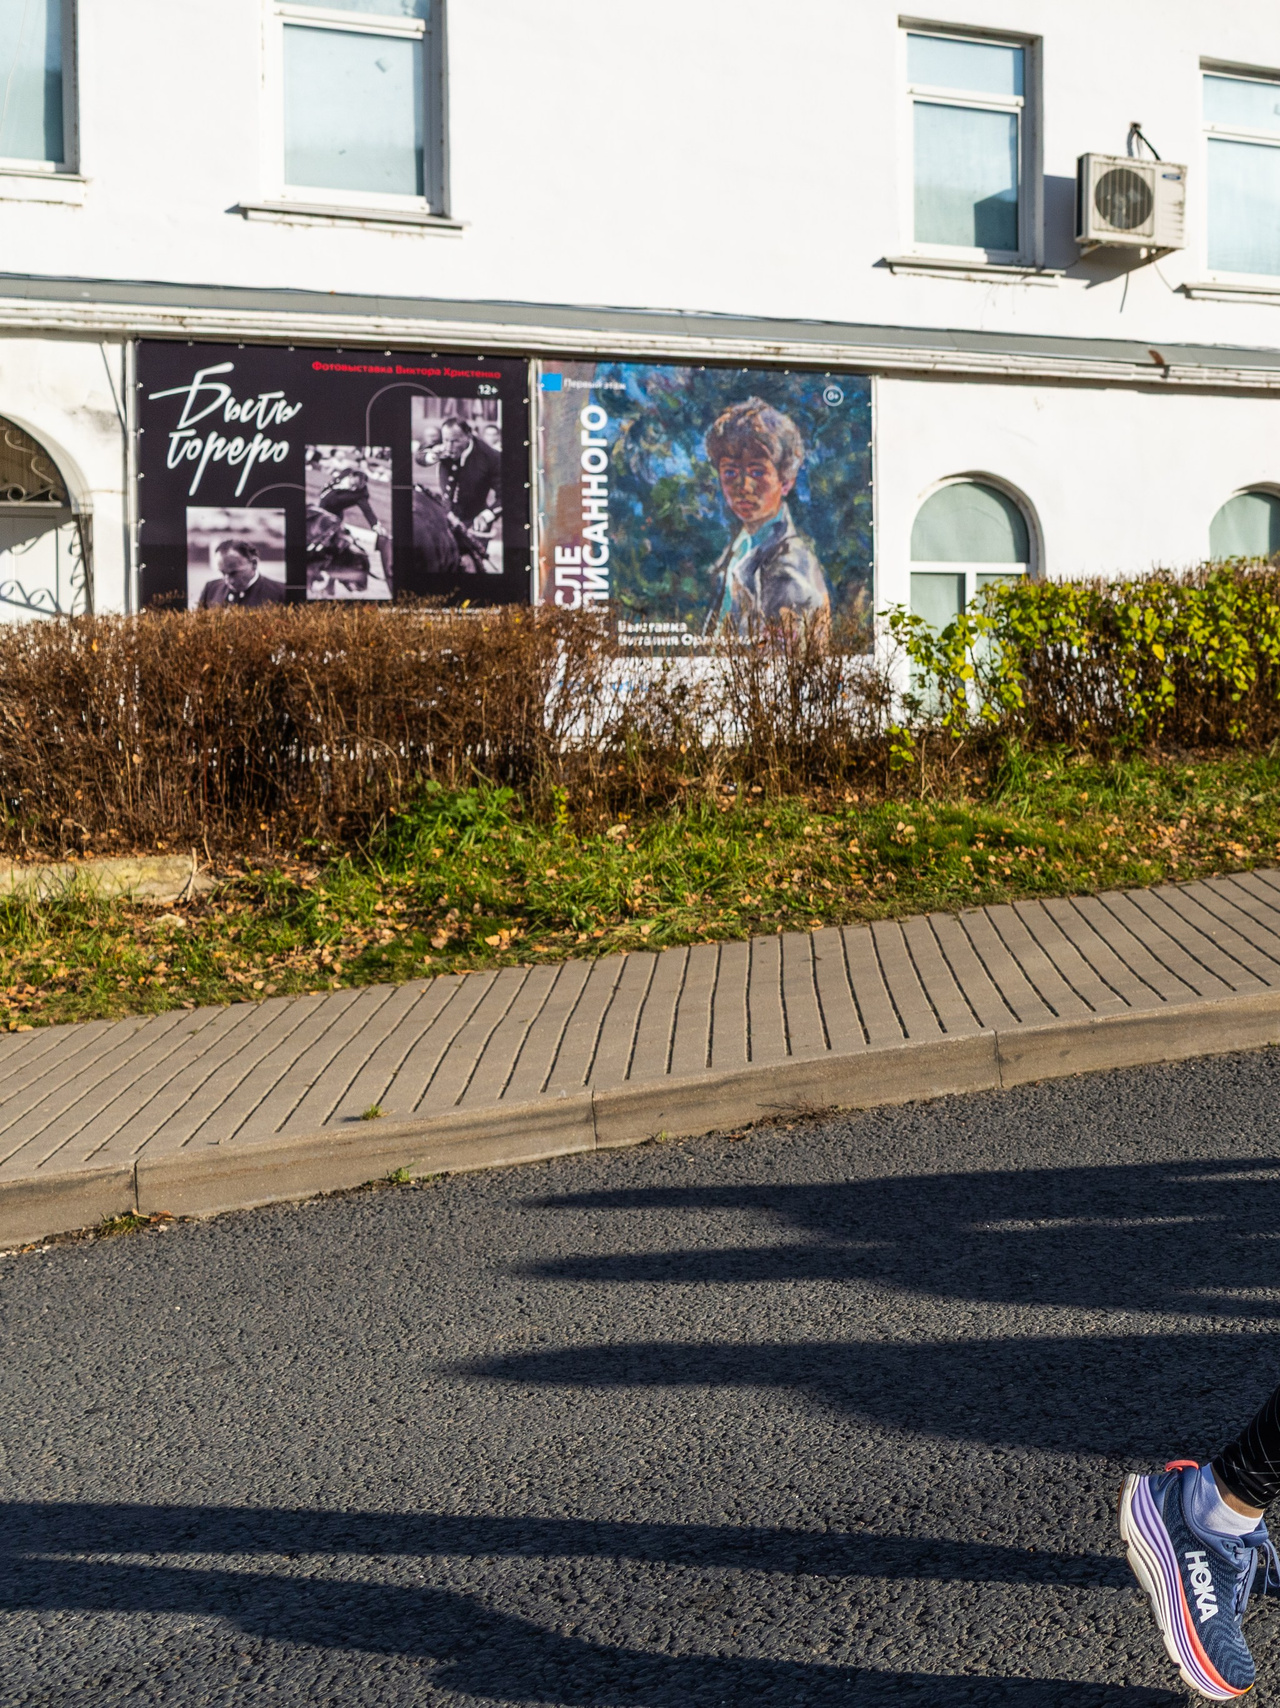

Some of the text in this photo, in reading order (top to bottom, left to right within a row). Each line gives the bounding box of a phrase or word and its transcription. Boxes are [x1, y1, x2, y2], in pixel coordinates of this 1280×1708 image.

[148, 361, 303, 430] Быть
[312, 361, 501, 379] Фотовыставка Виктора Христенко
[478, 383, 499, 396] 12+
[581, 403, 610, 613] ПИСАННОГО
[554, 545, 582, 612] СЛЕ
[1184, 1550, 1219, 1624] HOKA
